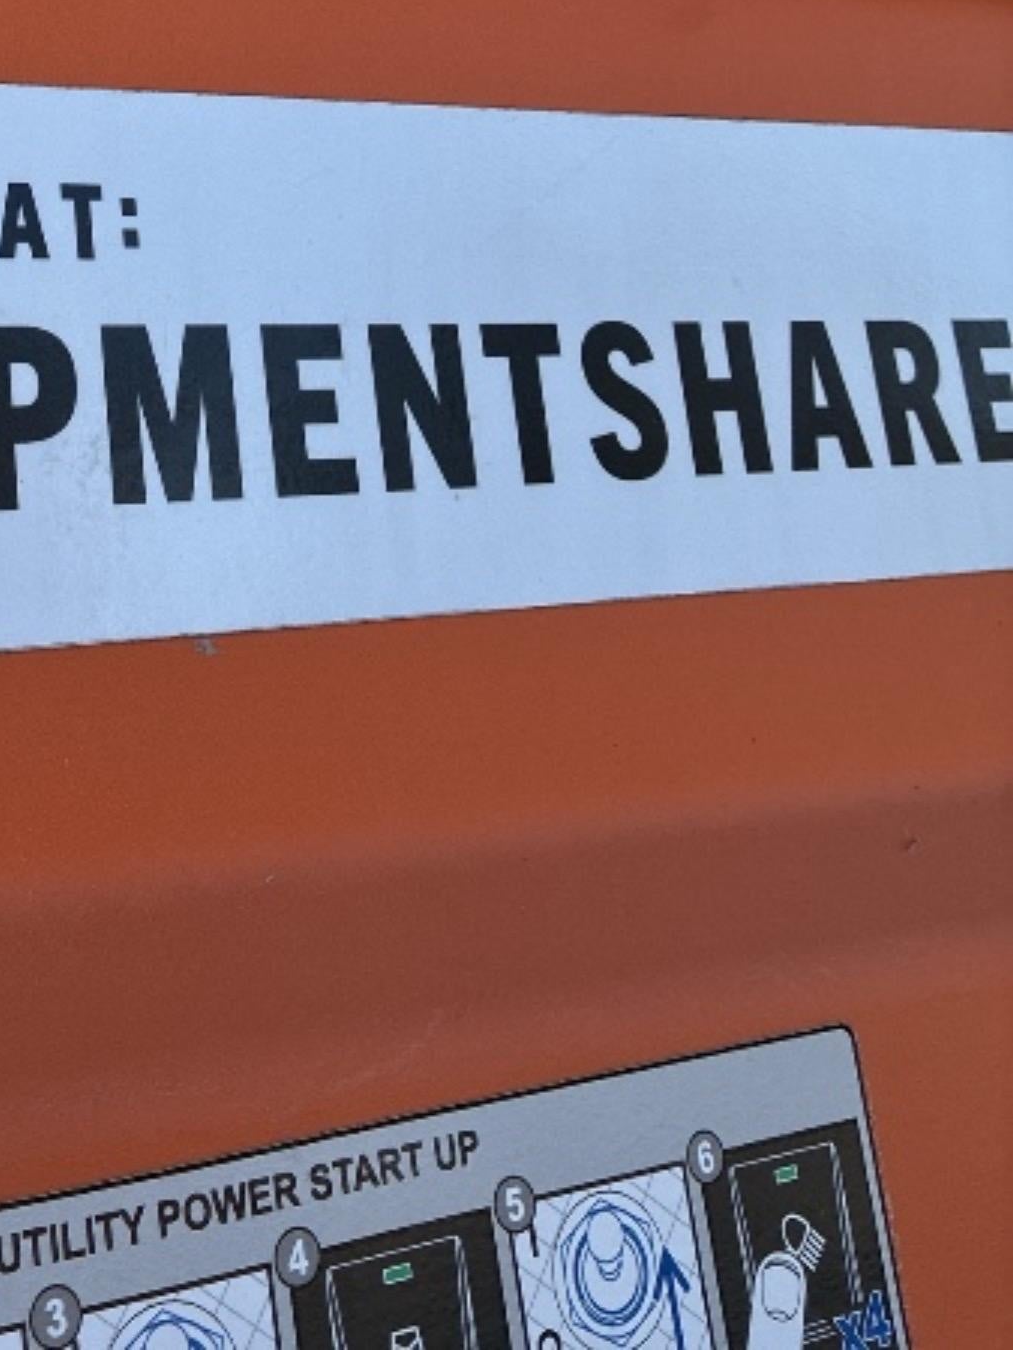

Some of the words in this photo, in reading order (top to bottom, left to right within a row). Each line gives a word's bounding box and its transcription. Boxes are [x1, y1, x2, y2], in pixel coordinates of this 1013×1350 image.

[697, 1139, 715, 1174] 6
[157, 1172, 301, 1238] POWER
[310, 1143, 424, 1201] START
[433, 1130, 479, 1171] UP
[505, 1187, 526, 1222] 5
[288, 1238, 309, 1275] 4
[45, 1298, 69, 1338] 3
